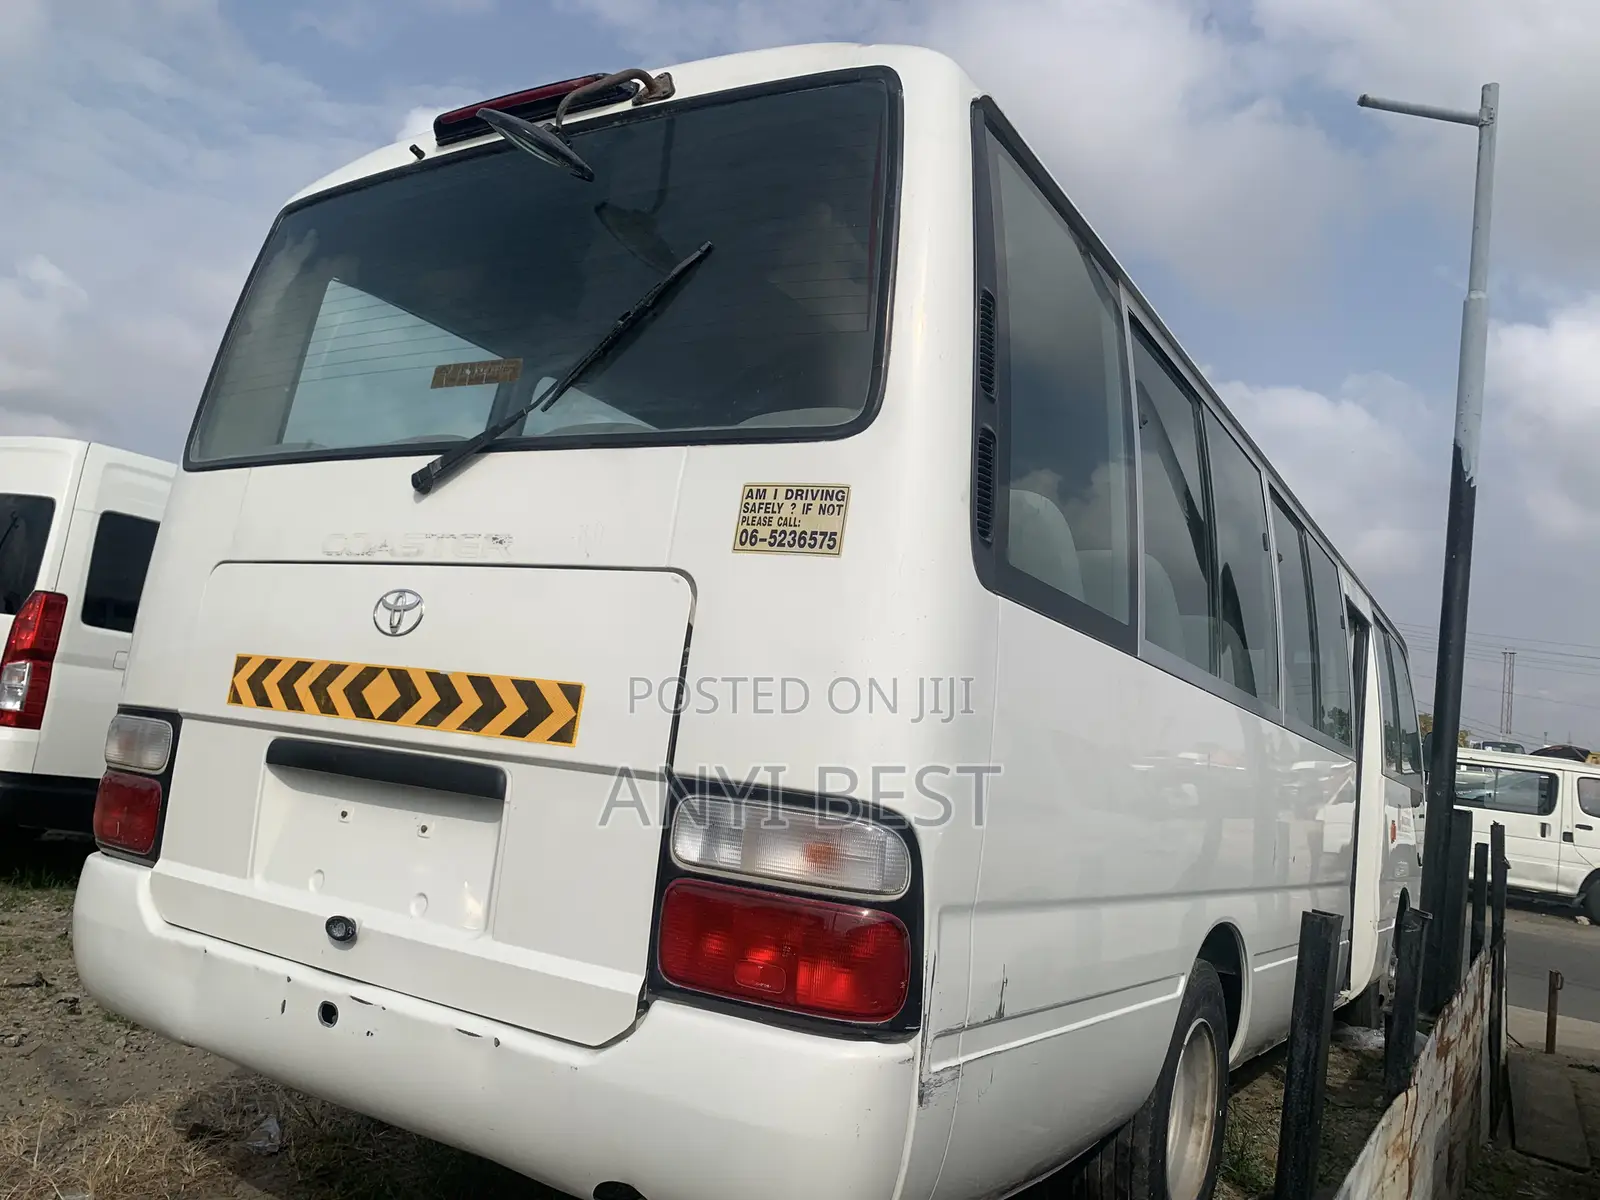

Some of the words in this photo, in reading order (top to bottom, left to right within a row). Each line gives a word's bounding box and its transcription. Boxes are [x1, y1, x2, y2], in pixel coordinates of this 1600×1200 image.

[745, 488, 766, 500] AM
[773, 488, 778, 500] I
[784, 489, 846, 502] DRIVING
[742, 502, 784, 515] SAFELY
[790, 503, 797, 515] ?
[802, 503, 813, 515] IF
[818, 504, 844, 516] NOT
[741, 516, 774, 527] PLEASE
[777, 516, 801, 528] CALL:
[739, 528, 838, 550] 06-5236575
